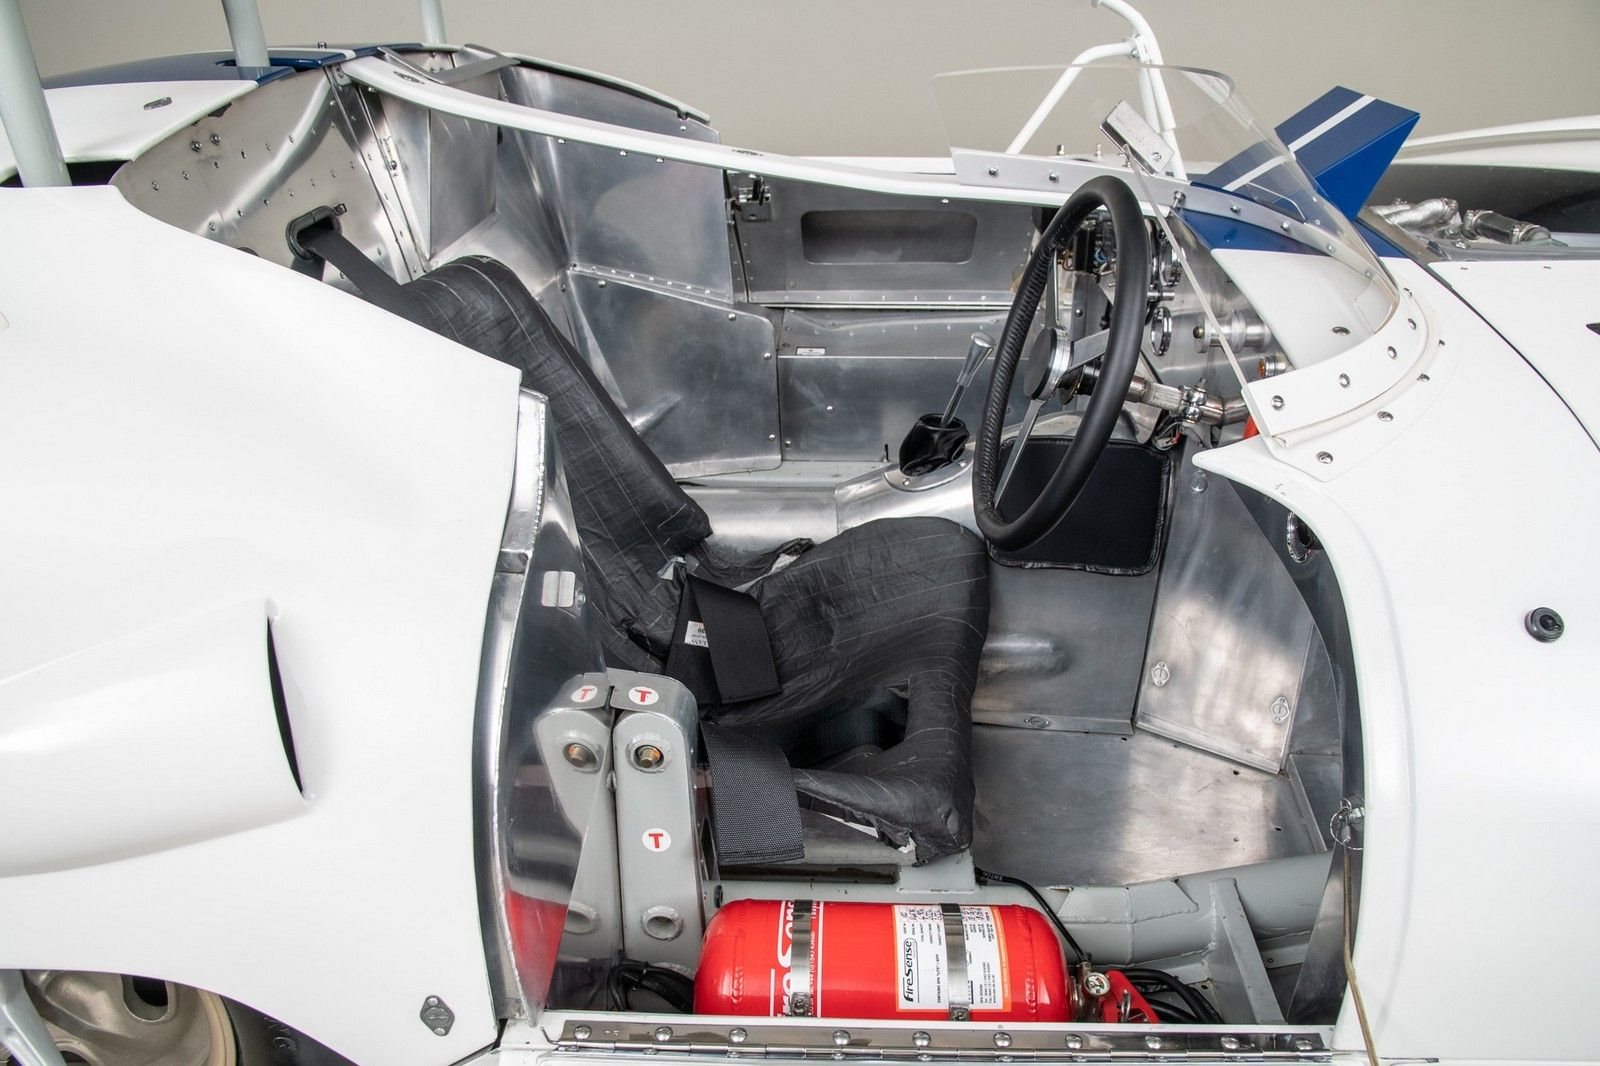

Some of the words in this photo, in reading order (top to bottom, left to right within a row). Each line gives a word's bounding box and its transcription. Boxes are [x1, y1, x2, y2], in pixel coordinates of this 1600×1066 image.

[580, 688, 594, 700] T
[635, 689, 652, 702] T
[648, 833, 663, 849] T
[903, 940, 914, 1002] FireSense
